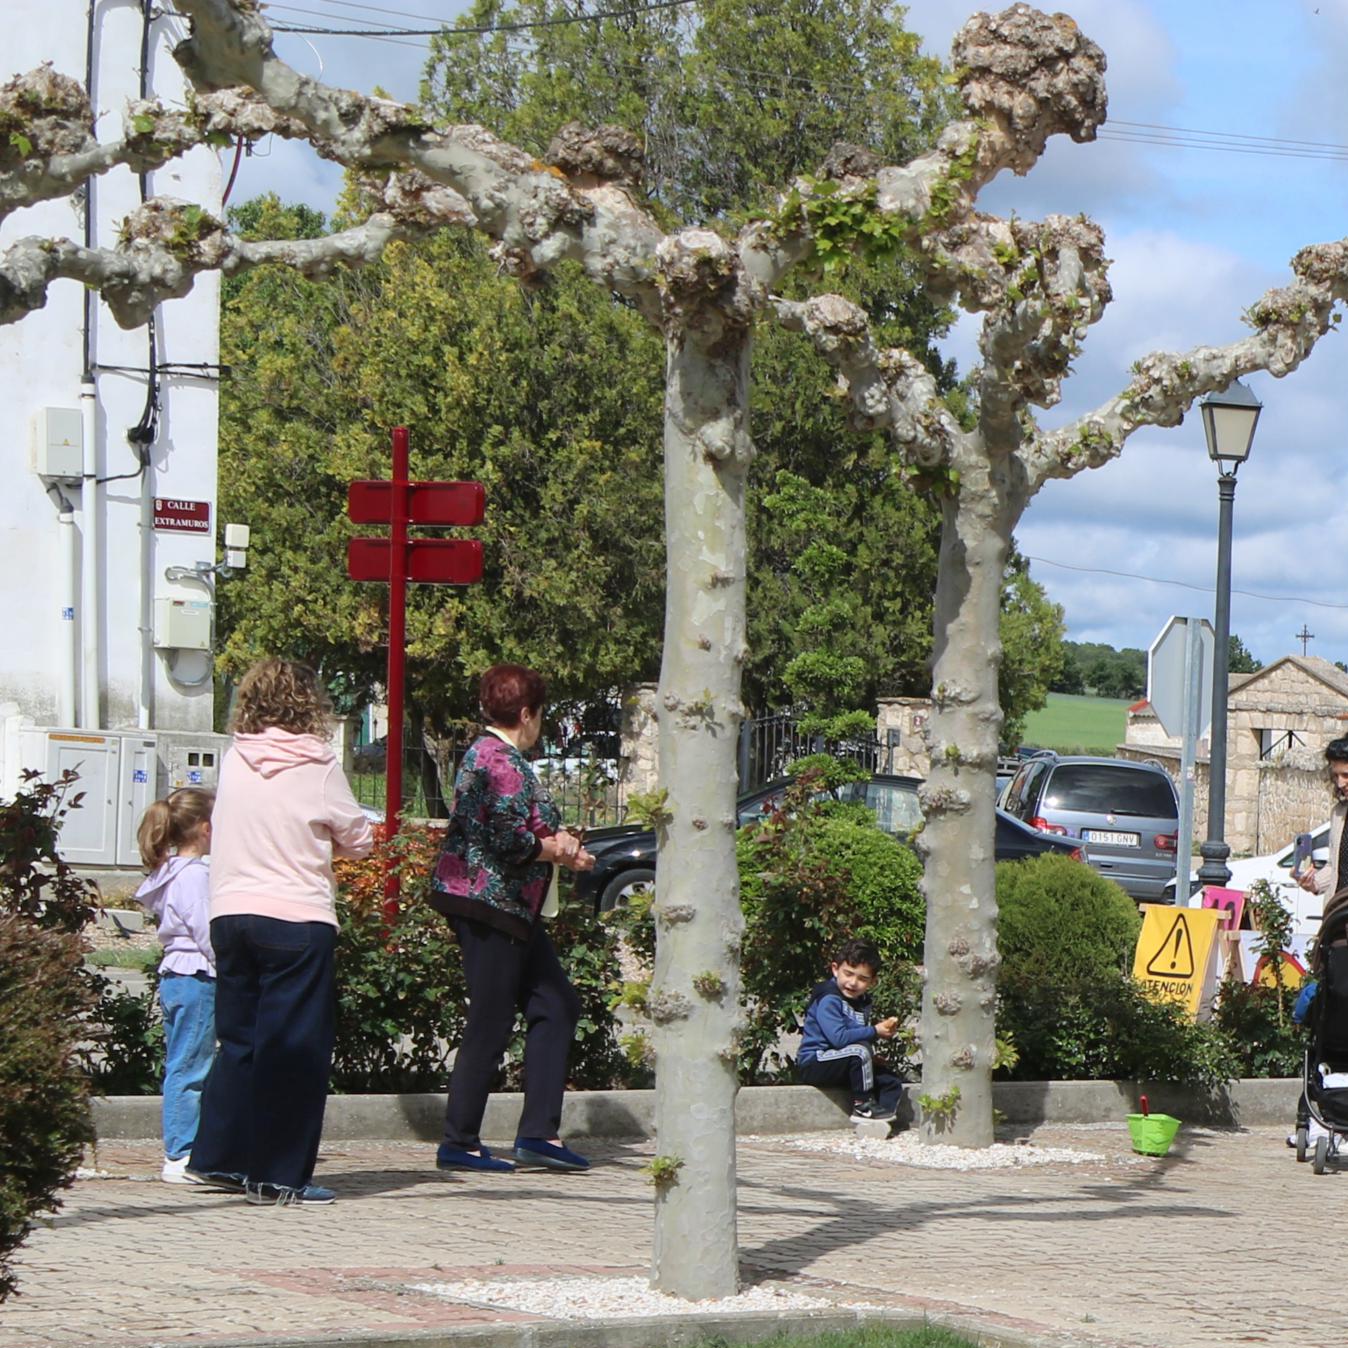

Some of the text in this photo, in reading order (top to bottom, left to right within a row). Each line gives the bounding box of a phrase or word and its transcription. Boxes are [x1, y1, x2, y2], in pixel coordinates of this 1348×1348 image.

[167, 501, 195, 511] CALLE
[155, 517, 208, 528] EXTRAMUROS
[1091, 832, 1135, 843] 0151 GNV
